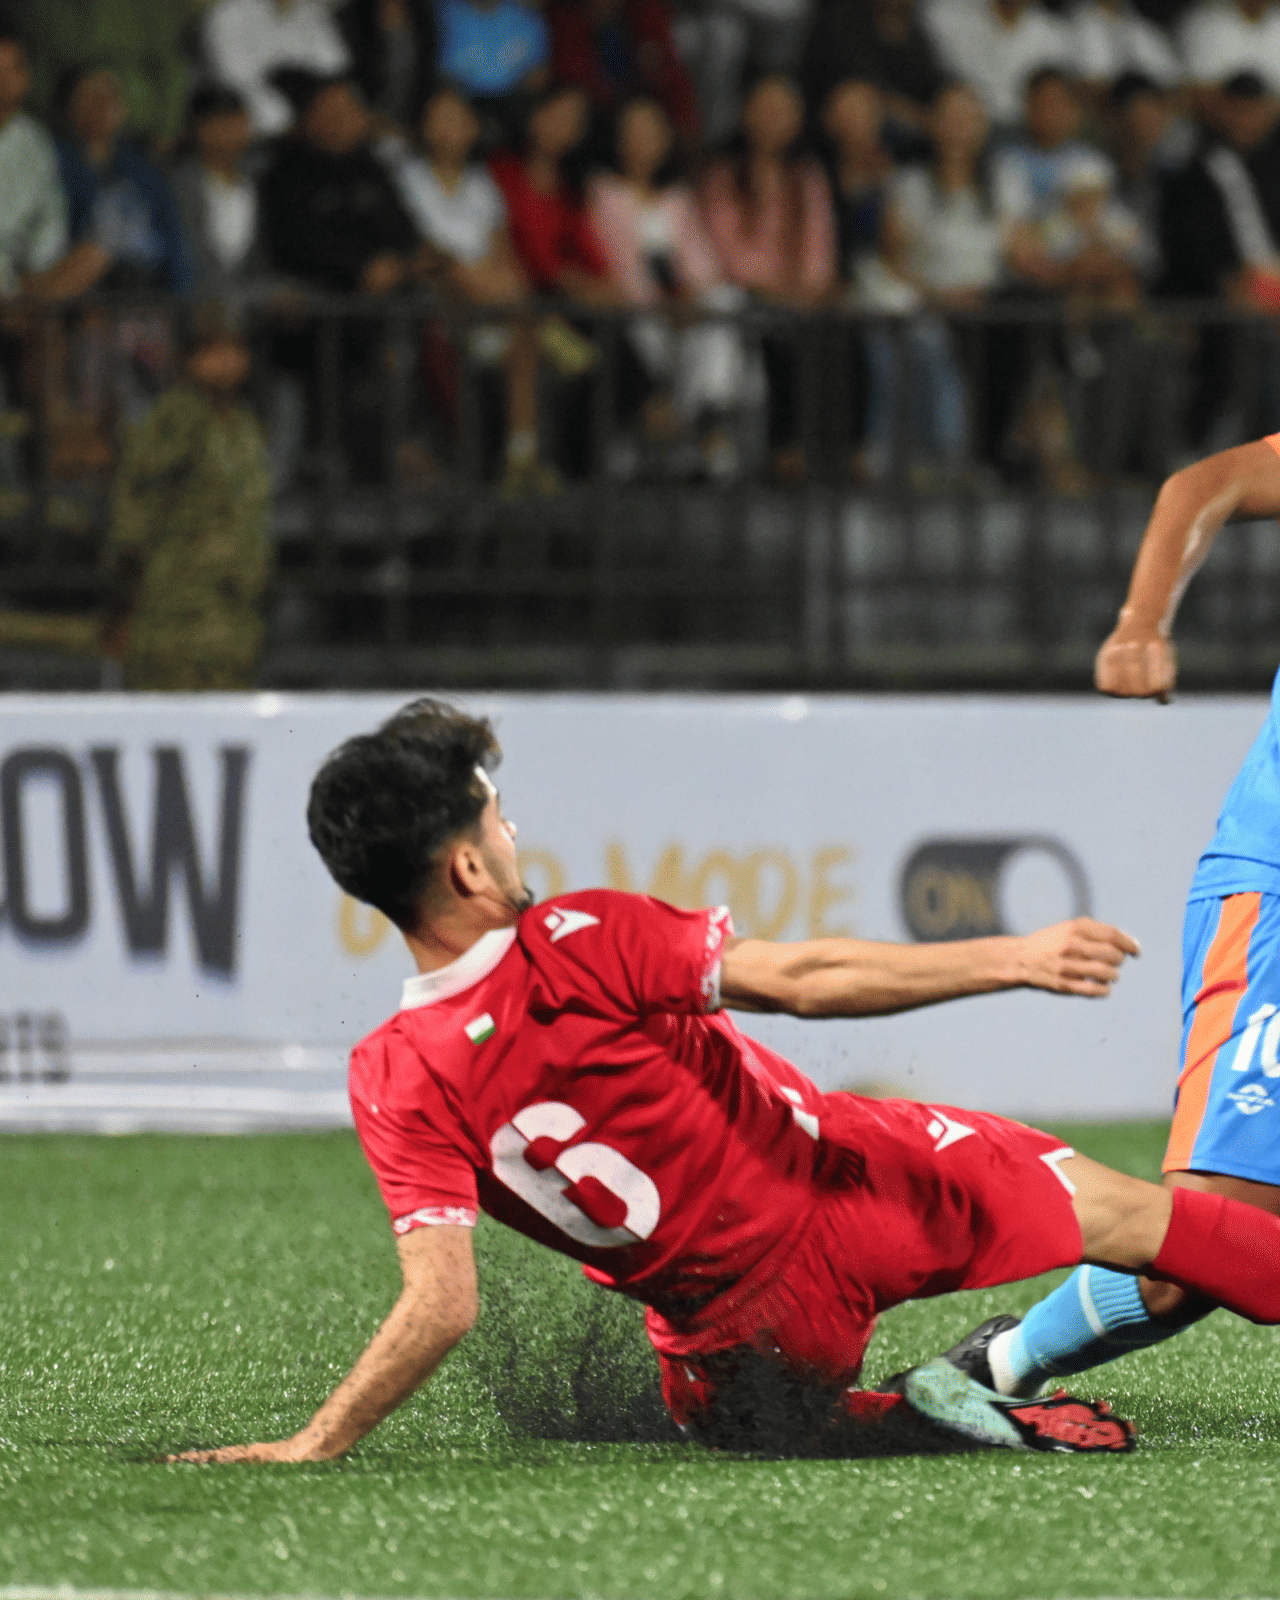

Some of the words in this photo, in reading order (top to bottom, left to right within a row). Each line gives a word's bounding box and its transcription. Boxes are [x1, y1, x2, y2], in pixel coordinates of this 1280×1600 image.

[0, 743, 253, 984] OW
[906, 866, 997, 934] ON
[490, 1101, 661, 1247] 6
